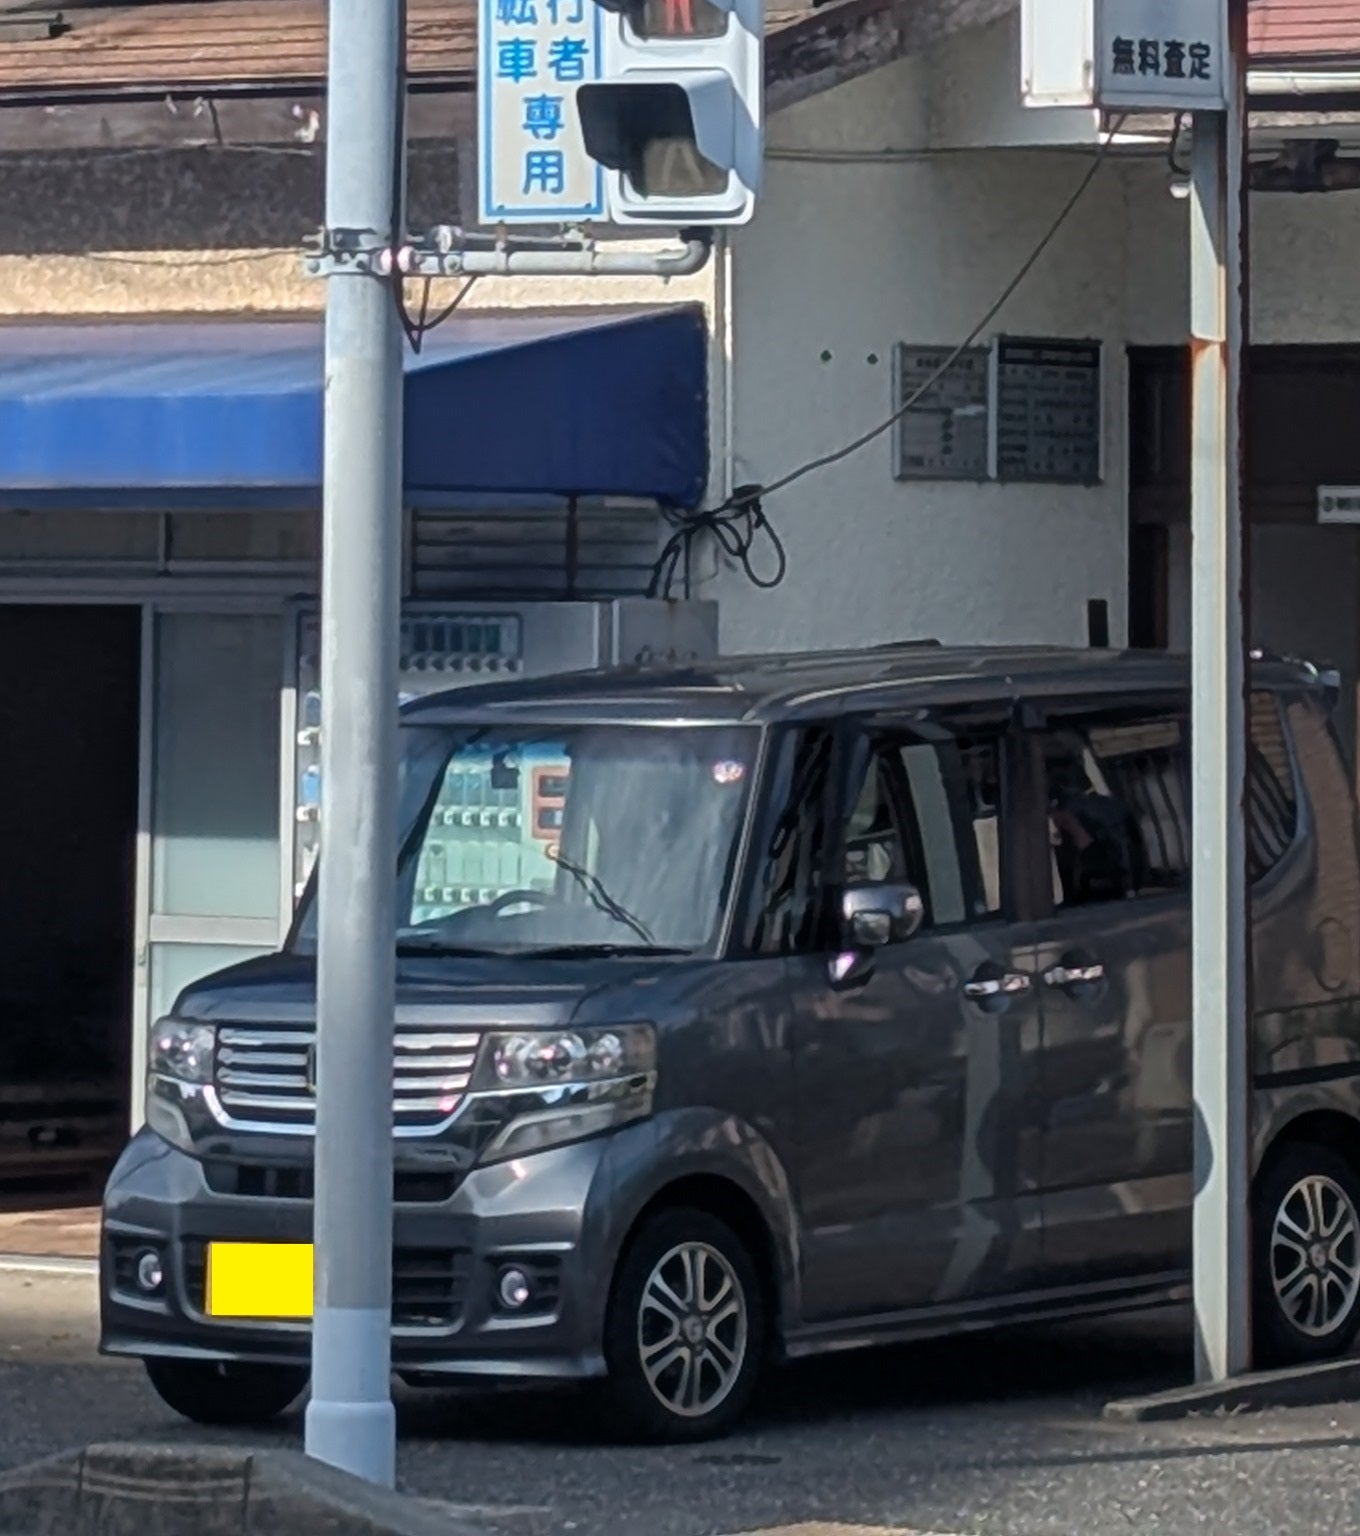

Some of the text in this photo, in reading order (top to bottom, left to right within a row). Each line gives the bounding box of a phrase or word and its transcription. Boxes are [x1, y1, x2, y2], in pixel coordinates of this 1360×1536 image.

[1111, 35, 1211, 80] 無料査定
[522, 93, 565, 195] 専用
